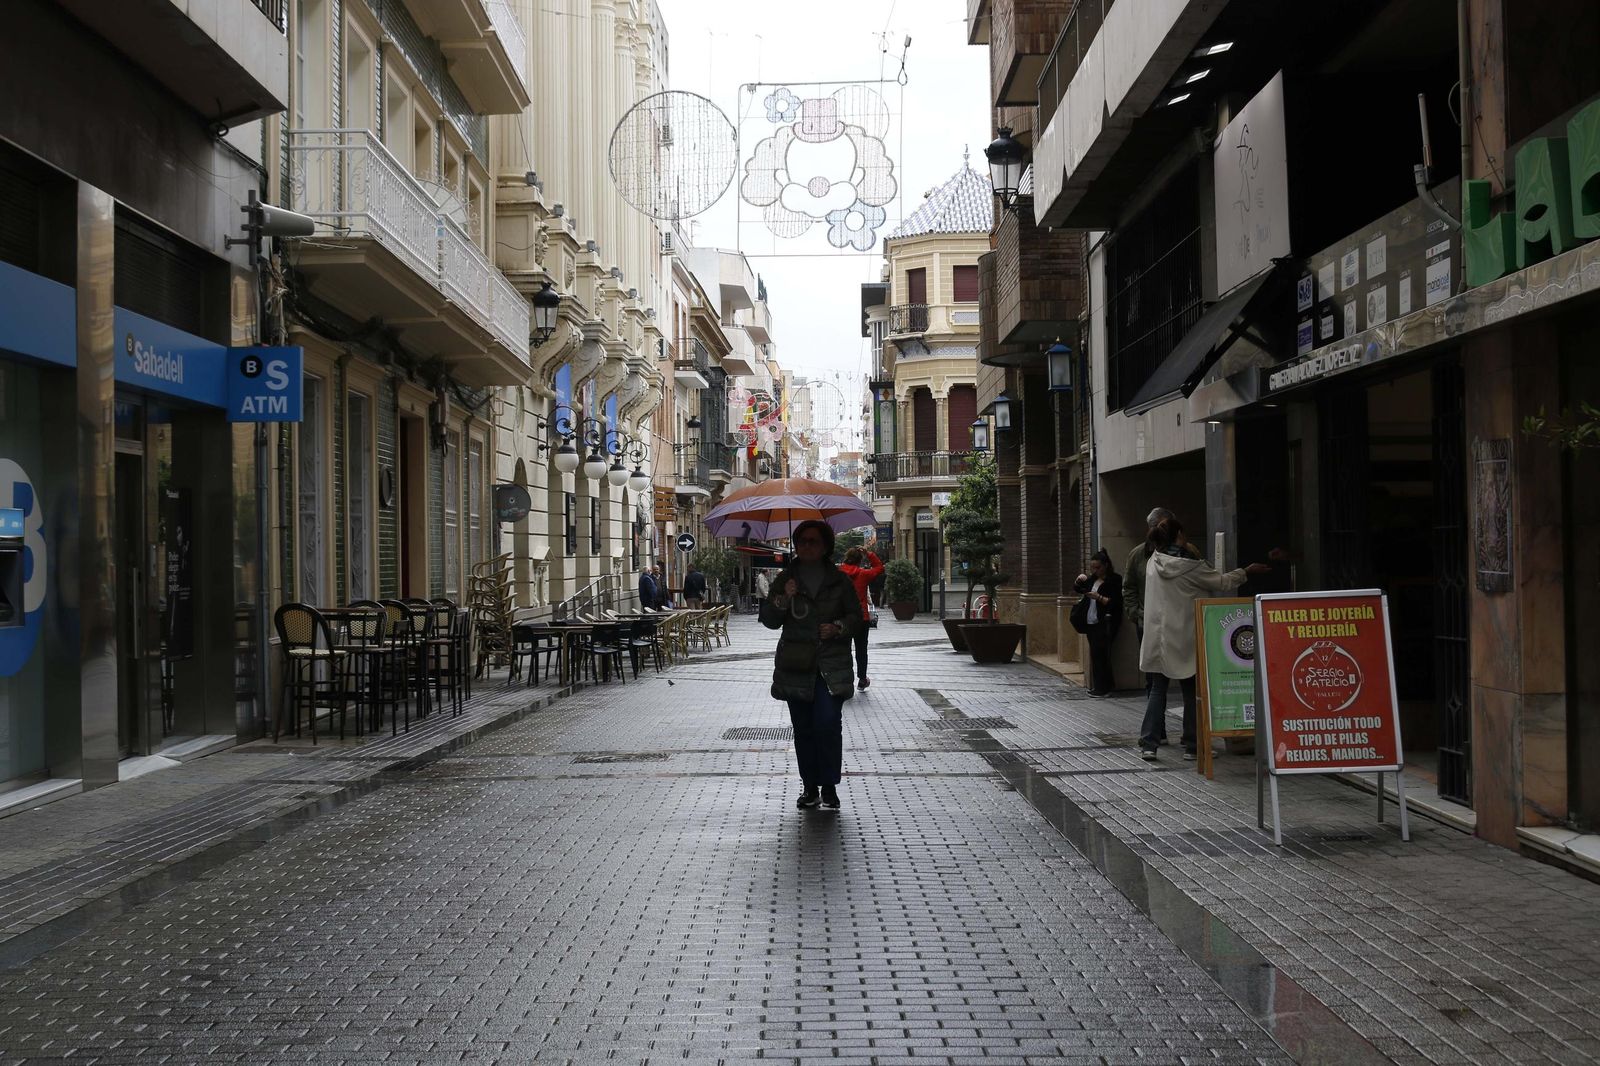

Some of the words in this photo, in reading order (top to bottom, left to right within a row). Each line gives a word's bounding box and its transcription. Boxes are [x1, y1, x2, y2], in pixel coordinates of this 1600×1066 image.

[134, 341, 183, 384] Sabadell
[246, 360, 257, 373] B
[264, 359, 290, 391] S
[240, 396, 287, 414] ATM
[1219, 613, 1235, 629] Art
[1236, 608, 1244, 617] &
[1267, 608, 1308, 623] TALLER
[1310, 608, 1326, 621] DE
[1327, 604, 1375, 621] JOYERÍA
[1287, 626, 1296, 639] Y
[1297, 622, 1358, 638] RELOJERÍA
[1308, 667, 1344, 678] SERGIO
[1305, 676, 1349, 688] PATRICIO
[1282, 716, 1352, 732] SUSTITUCIÓN
[1352, 716, 1382, 729] TODO
[1298, 733, 1322, 746] TIPO
[1324, 733, 1337, 745] DE
[1339, 732, 1369, 745] PILAS
[1286, 749, 1330, 762] RELOJES,
[1331, 747, 1384, 761] MANDOS...
